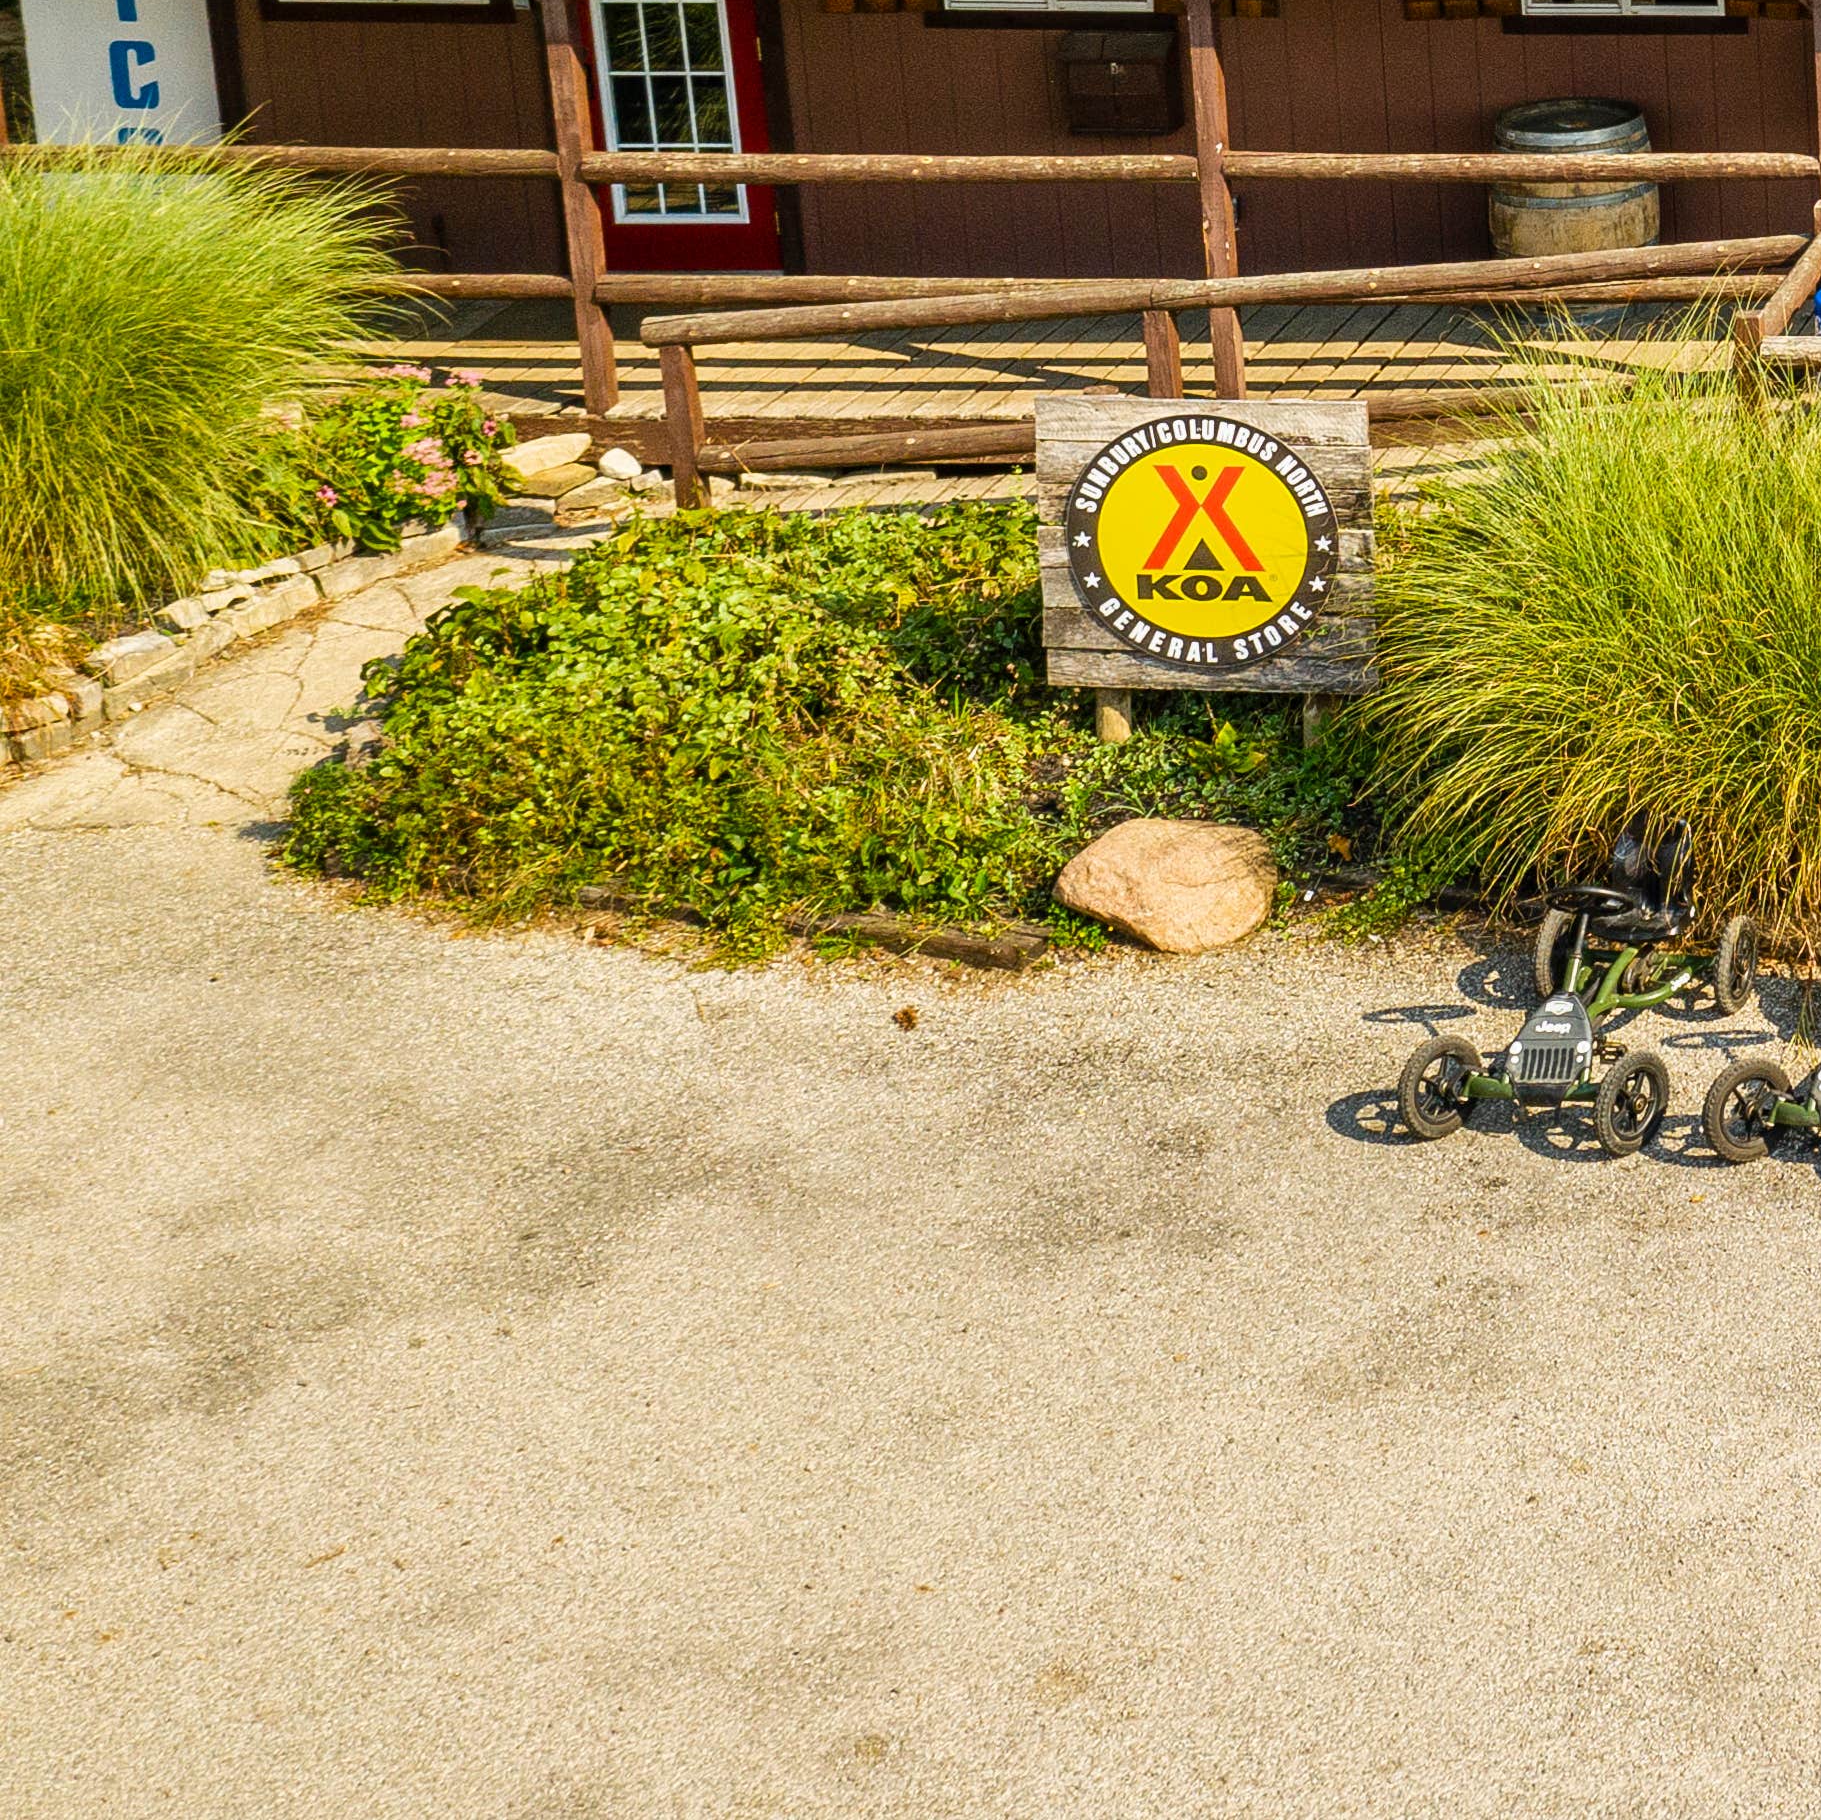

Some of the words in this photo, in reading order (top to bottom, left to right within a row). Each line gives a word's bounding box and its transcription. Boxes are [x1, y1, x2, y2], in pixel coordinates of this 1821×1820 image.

[1075, 418, 1278, 513] SUNBURY/COLUMBUS
[1275, 455, 1329, 518] NORTH
[1136, 574, 1273, 603] KOA
[1099, 597, 1219, 663] GENERAL
[1233, 600, 1314, 661] STORE
[1535, 1020, 1572, 1035] Jeep
